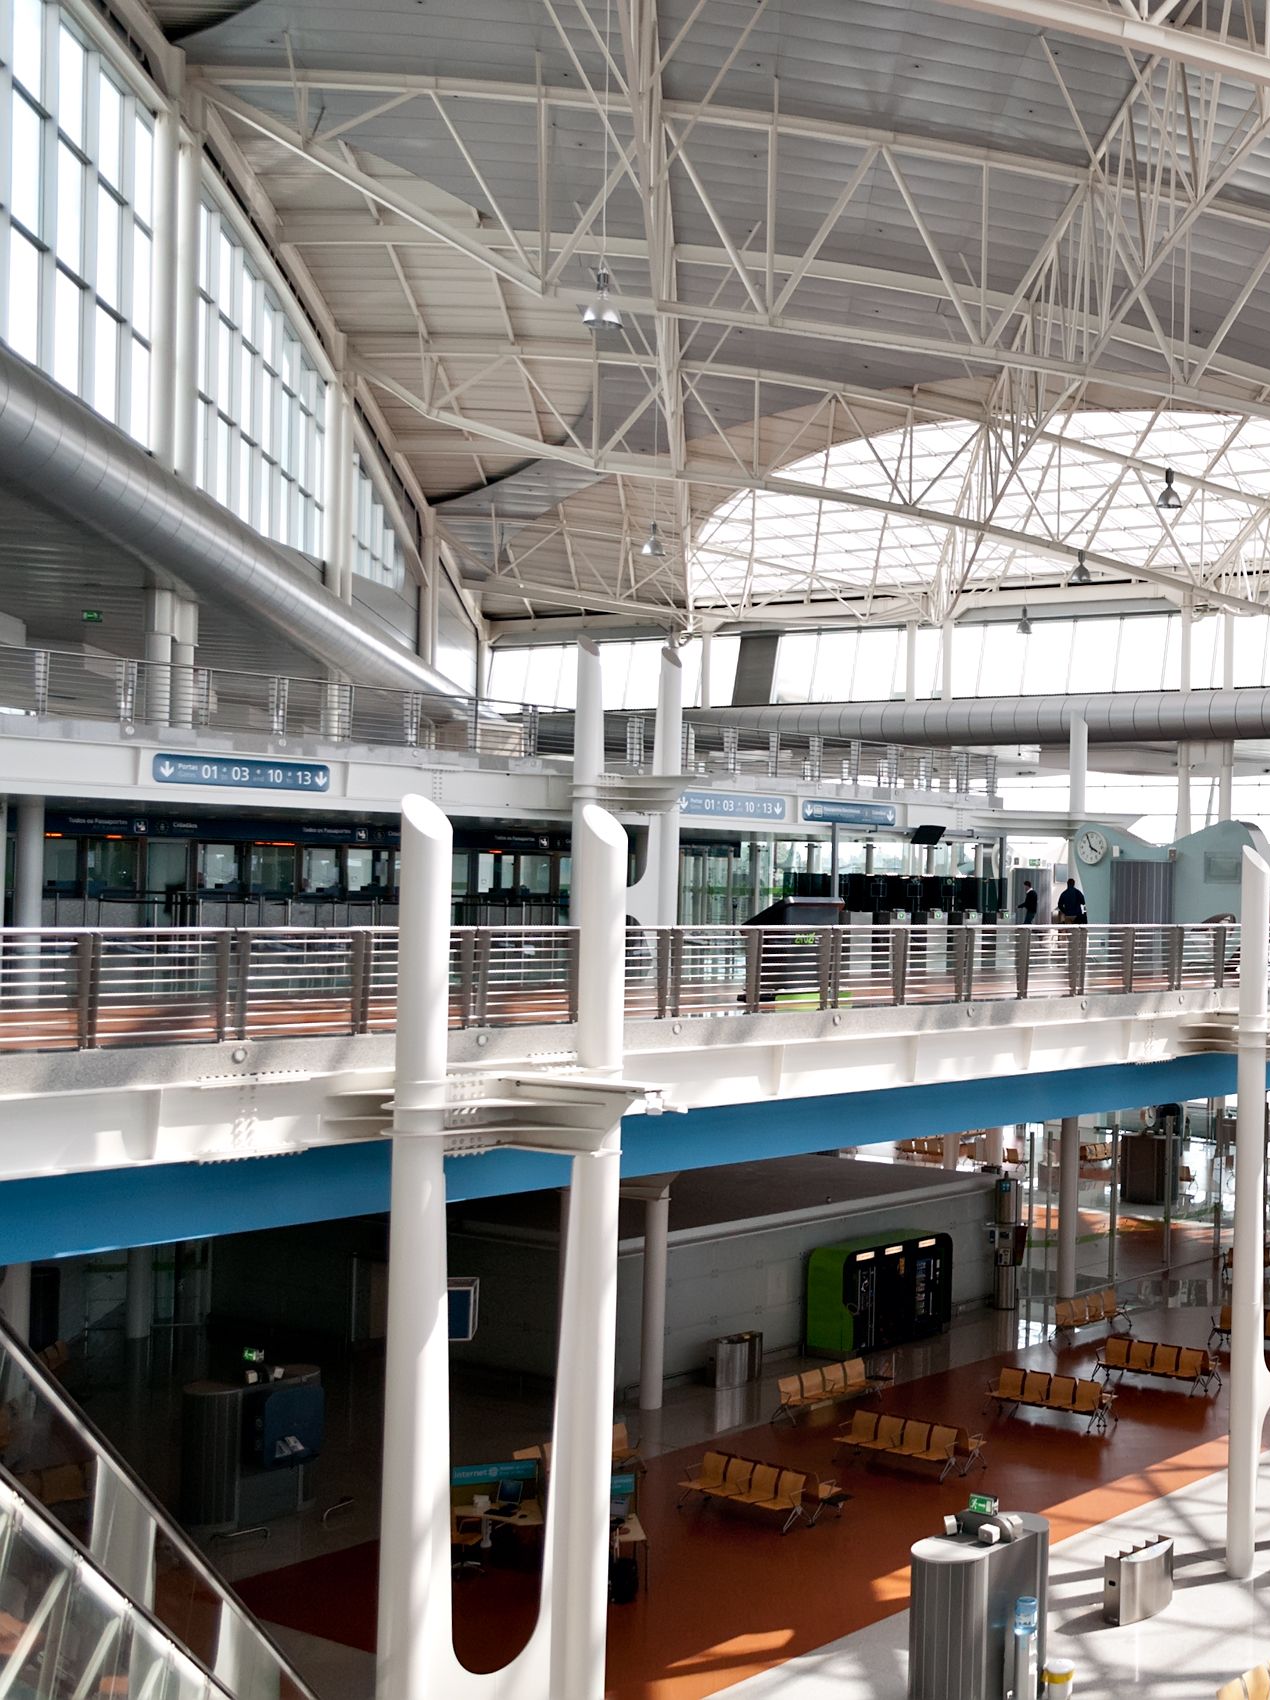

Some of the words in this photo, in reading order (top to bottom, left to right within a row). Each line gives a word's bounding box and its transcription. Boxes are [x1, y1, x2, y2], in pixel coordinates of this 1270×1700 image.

[202, 764, 218, 779] 01
[232, 766, 250, 781] 03
[267, 769, 283, 783] 10
[296, 771, 312, 785] 13
[704, 799, 715, 810] 01
[722, 800, 734, 811] 03
[745, 801, 755, 813] 10
[763, 803, 773, 814] 13
